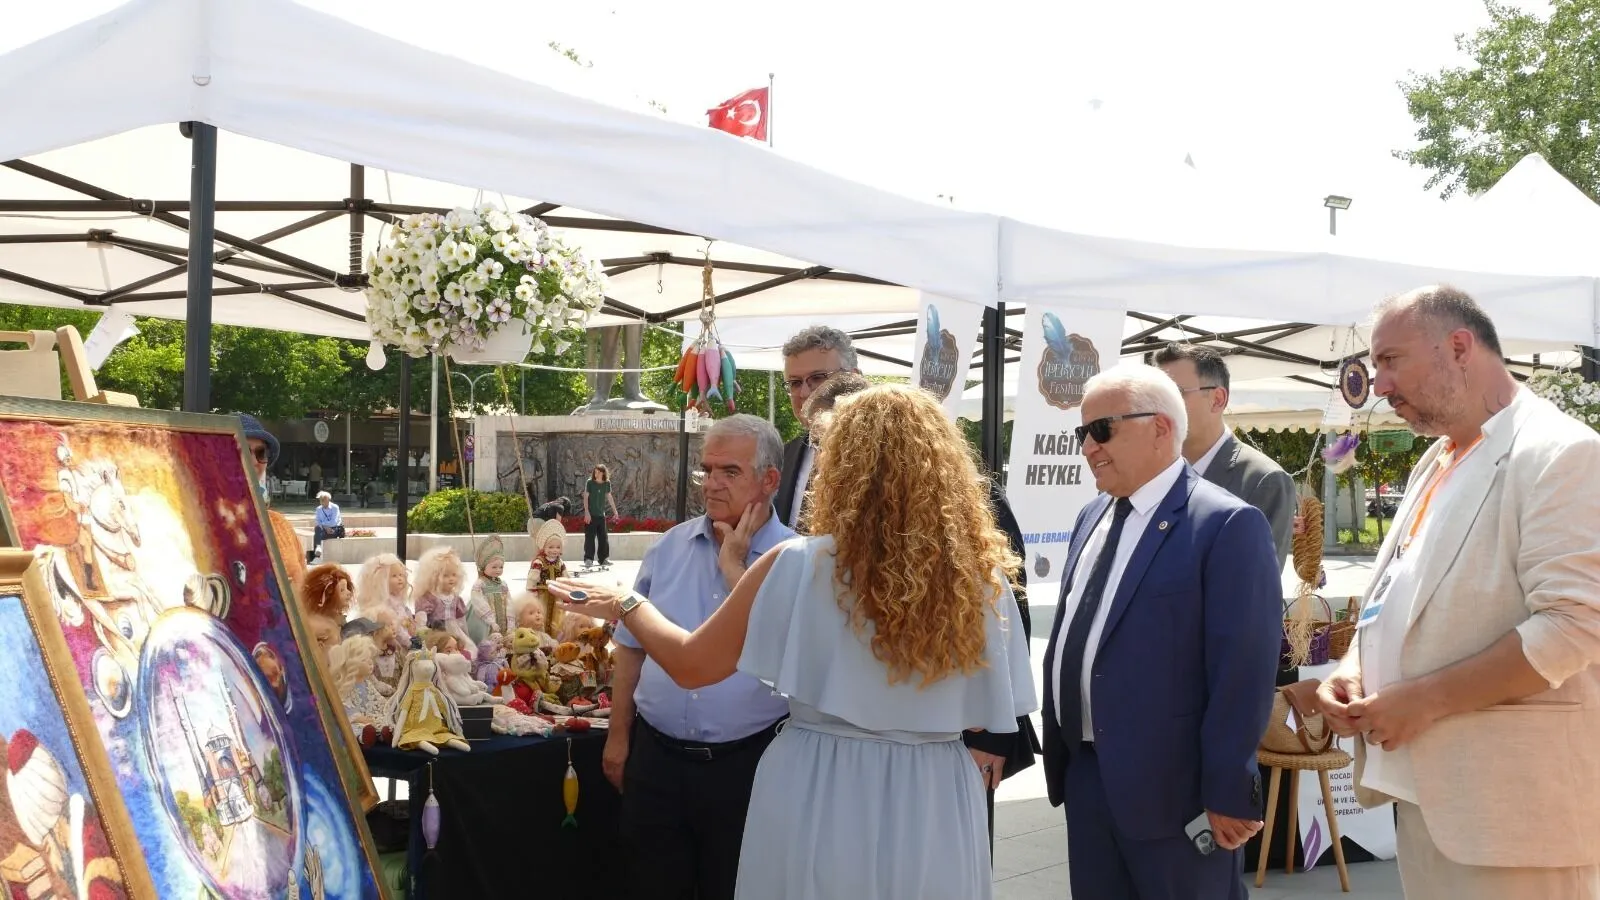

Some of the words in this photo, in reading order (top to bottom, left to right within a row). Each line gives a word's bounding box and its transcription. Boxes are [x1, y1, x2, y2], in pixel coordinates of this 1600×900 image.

[1025, 464, 1082, 485] HEYKEL
[1022, 533, 1040, 544] HAD
[1041, 530, 1071, 543] EBRAHİ
